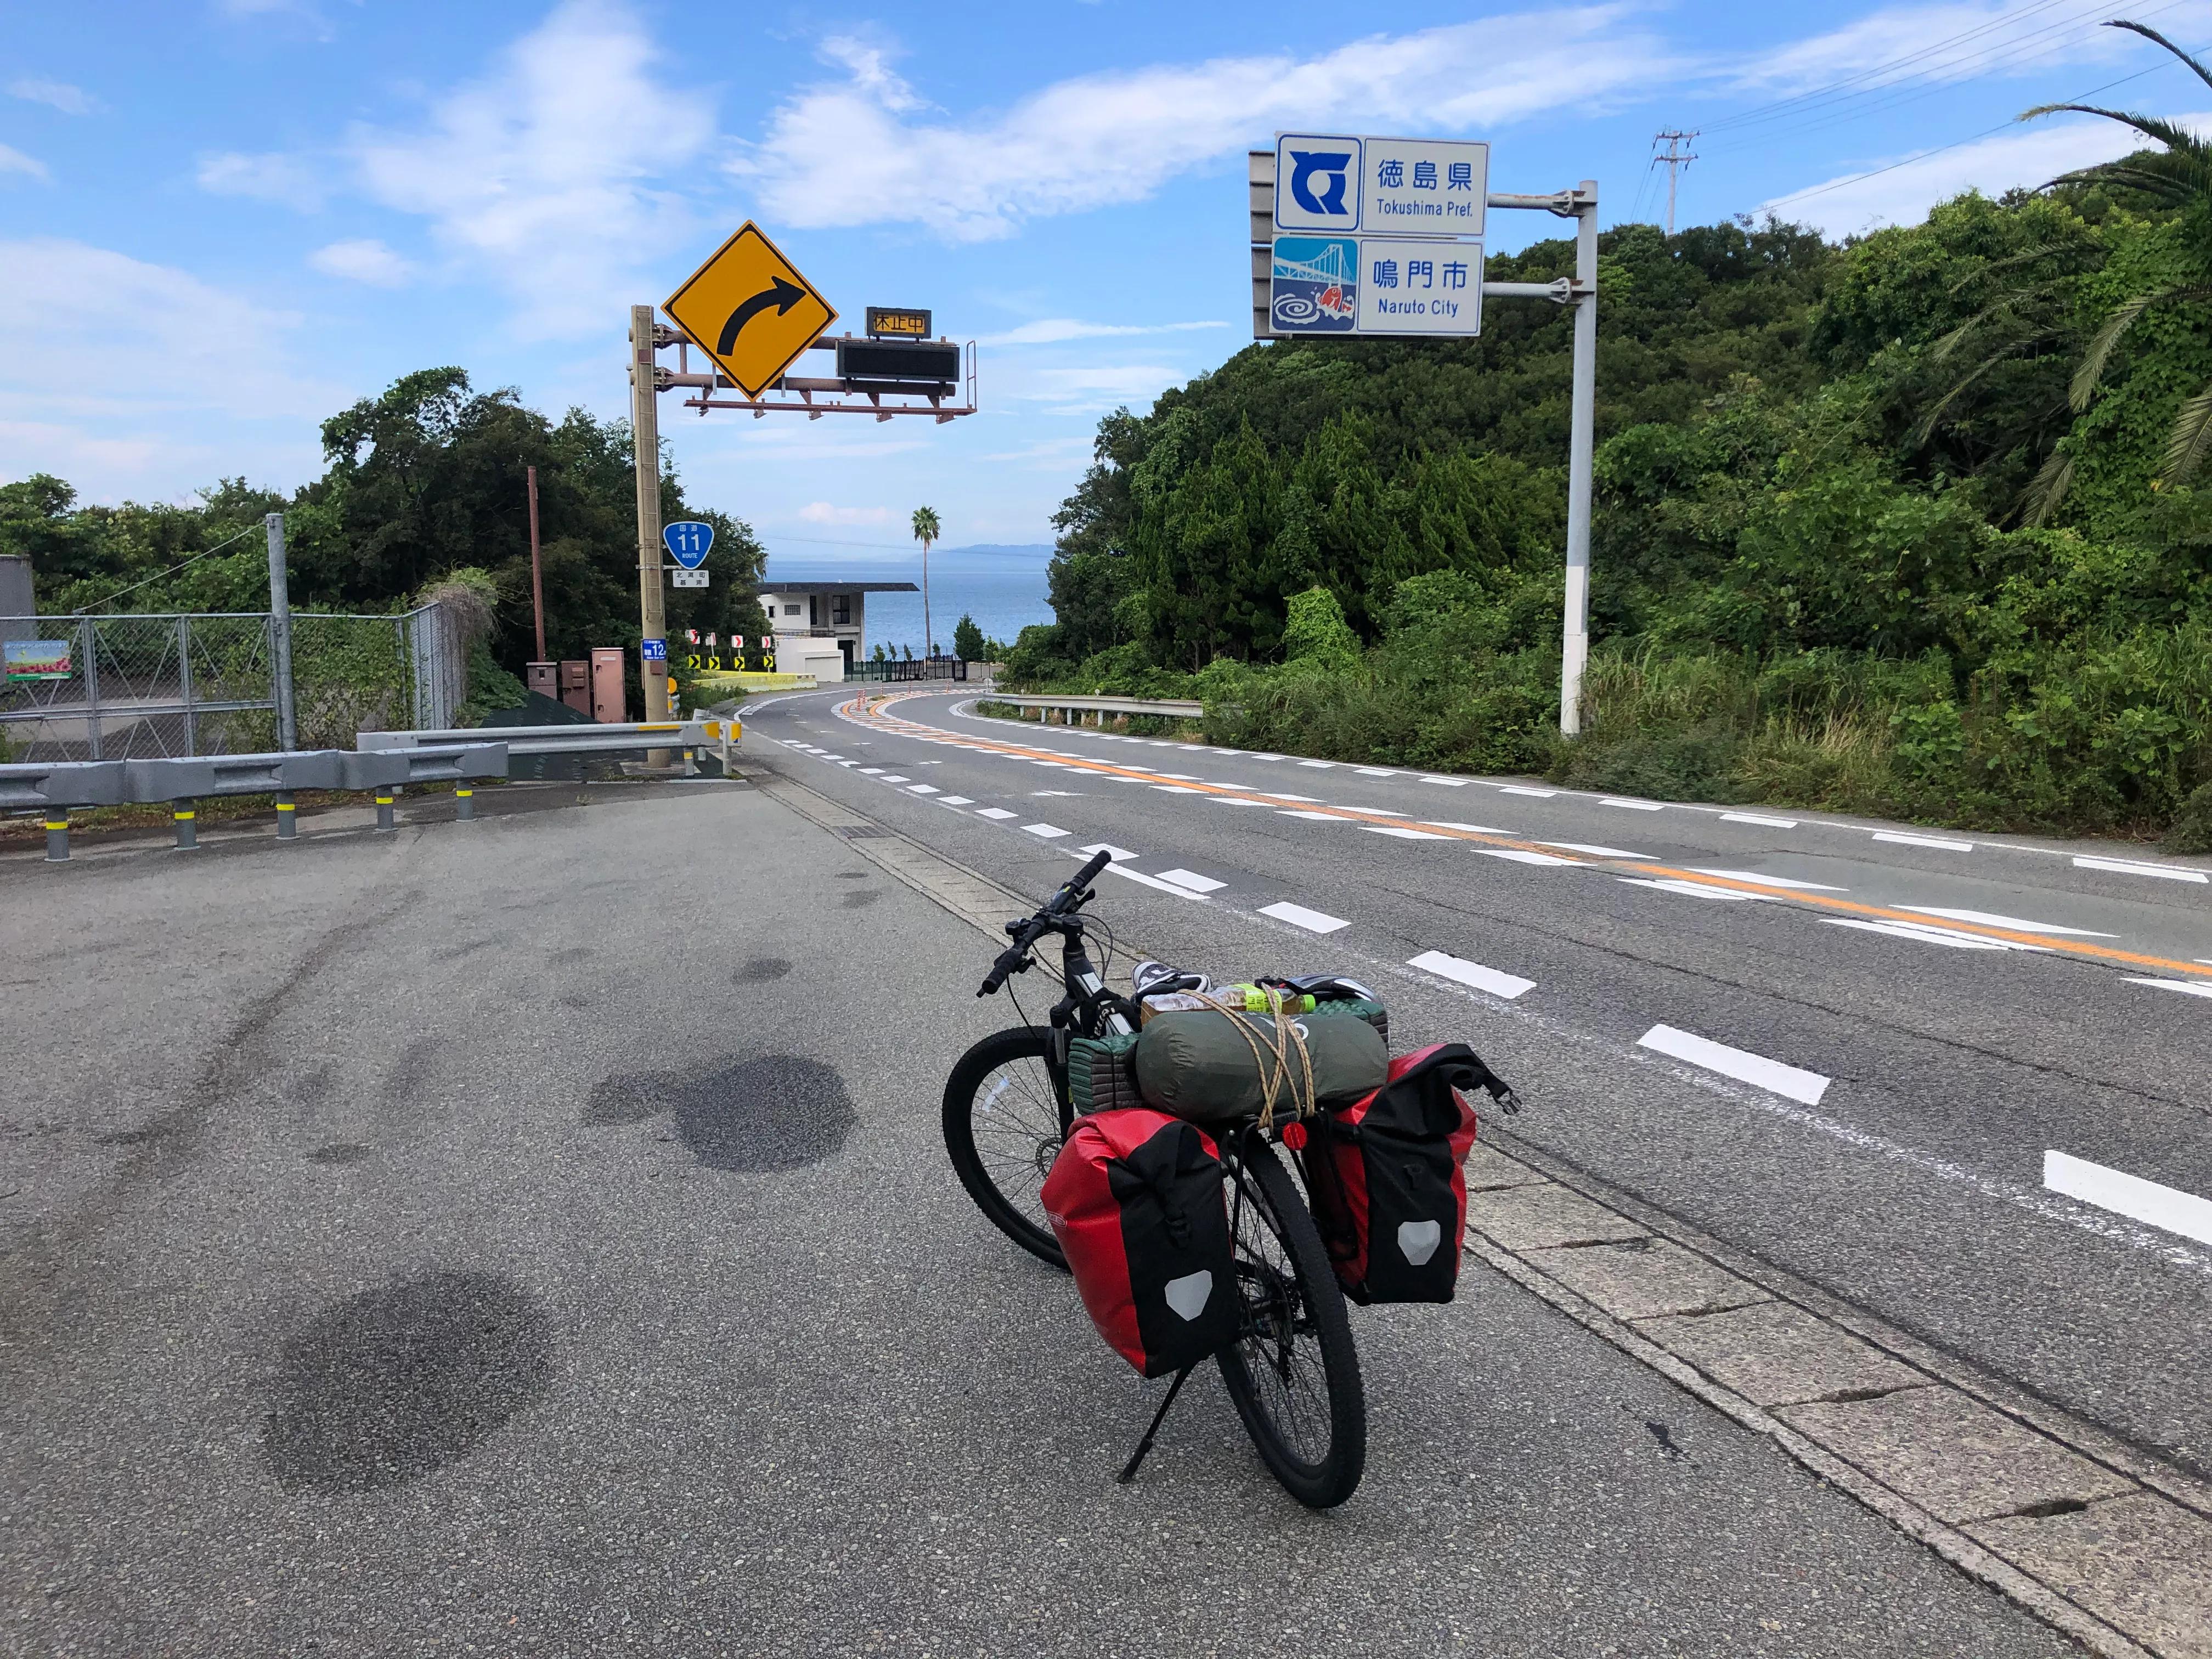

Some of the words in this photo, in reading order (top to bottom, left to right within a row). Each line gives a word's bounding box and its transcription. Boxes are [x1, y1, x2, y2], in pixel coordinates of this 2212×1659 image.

[1378, 159, 1472, 191] 徳島県
[1377, 199, 1442, 216] Tokushima
[1447, 202, 1473, 217] Pref.
[1373, 259, 1468, 290] 鳴門市
[1378, 299, 1425, 314] Naruto
[1431, 300, 1459, 318] City
[873, 313, 923, 332] 休止中
[678, 534, 699, 551] 11
